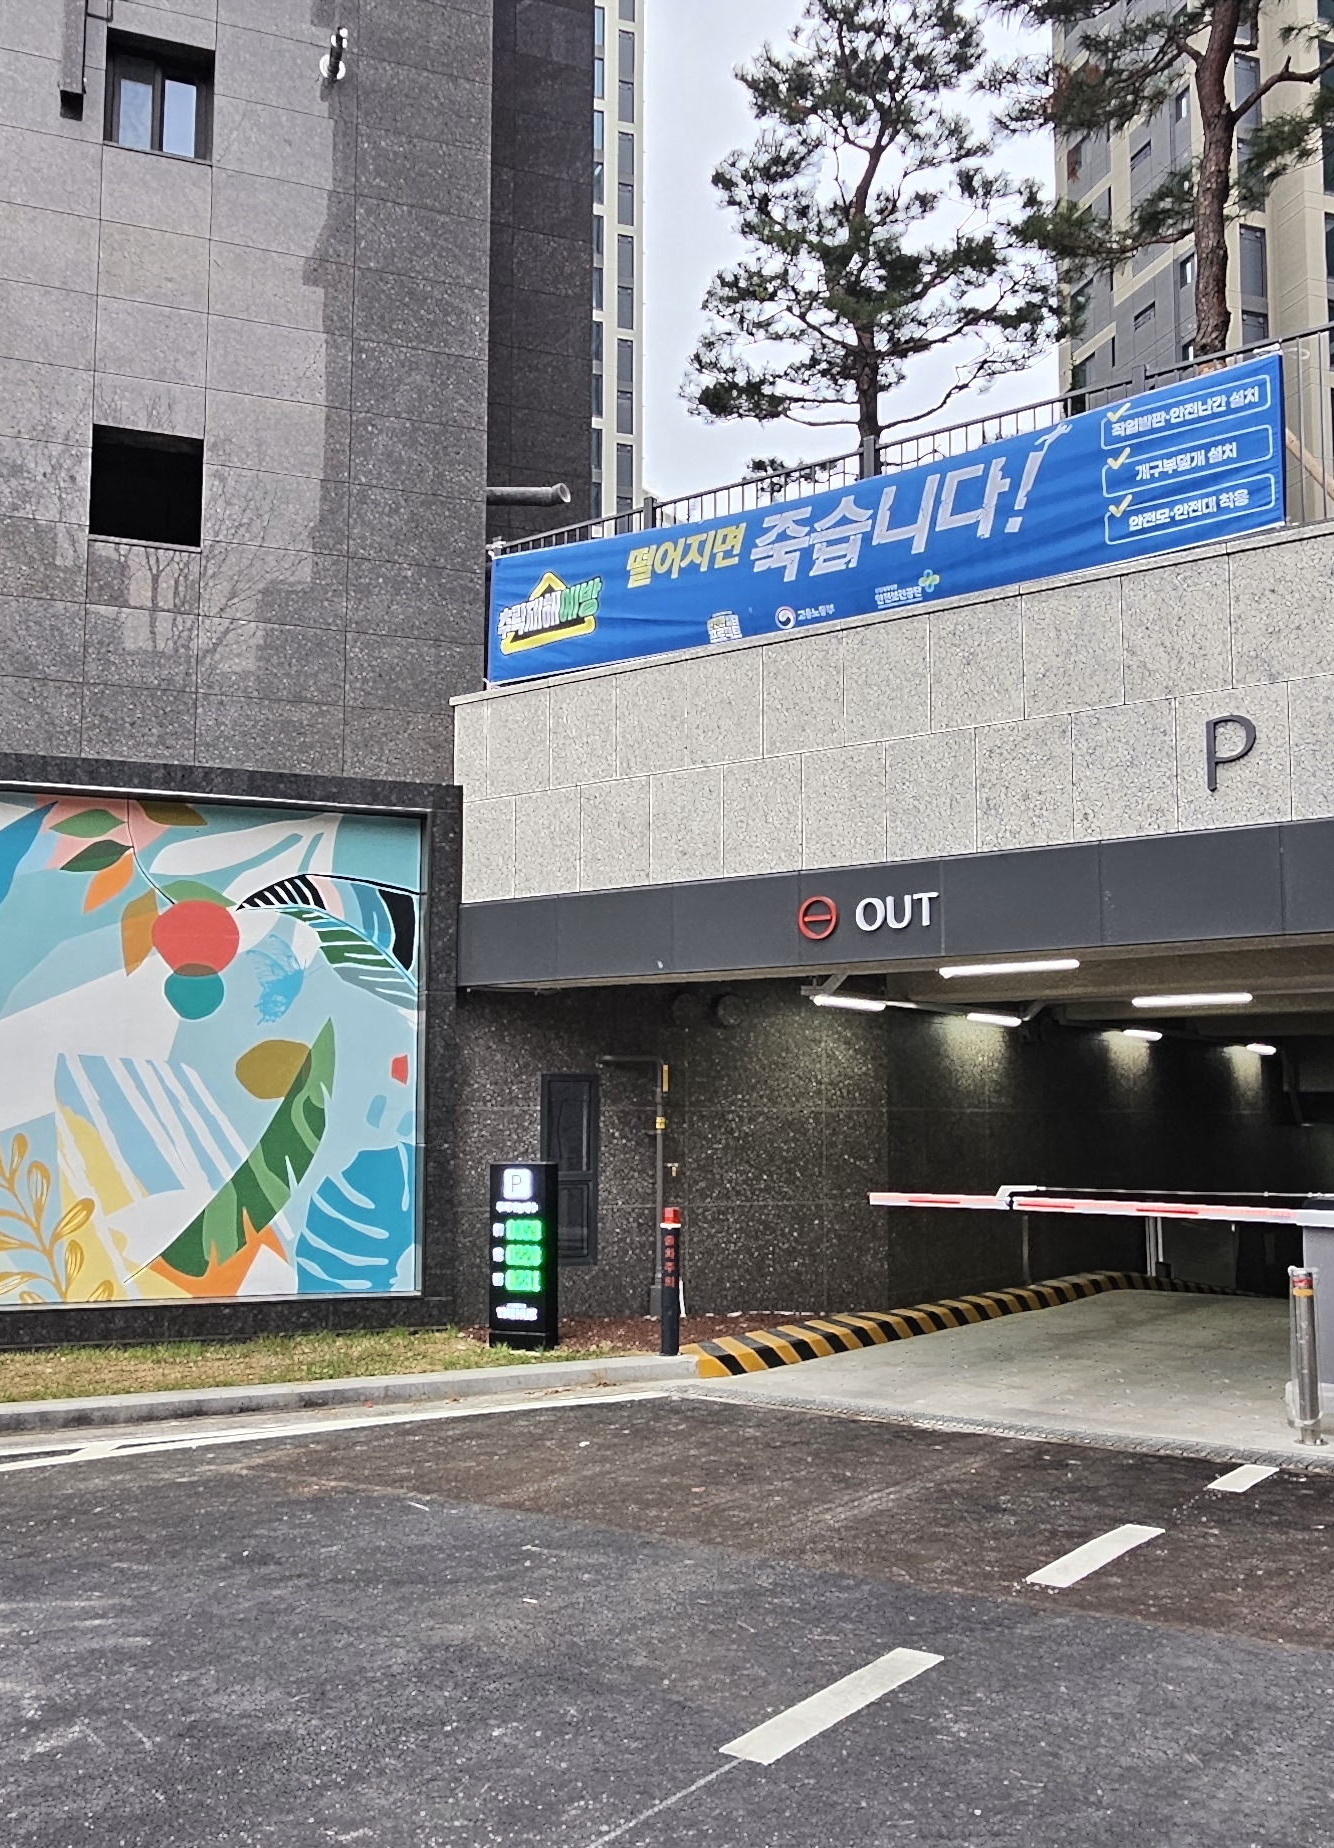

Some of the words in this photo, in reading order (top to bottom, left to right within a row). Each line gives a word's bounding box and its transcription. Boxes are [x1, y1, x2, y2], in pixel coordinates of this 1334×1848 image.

[1229, 386, 1259, 409] 설치
[1135, 450, 1206, 481] 개구부덮개
[1208, 442, 1237, 462] 설치
[627, 522, 747, 589] 떨어지면
[750, 446, 1041, 582] 죽습니다!
[1219, 489, 1249, 509] 착용
[1206, 714, 1256, 793] P
[855, 892, 939, 932] OUT
